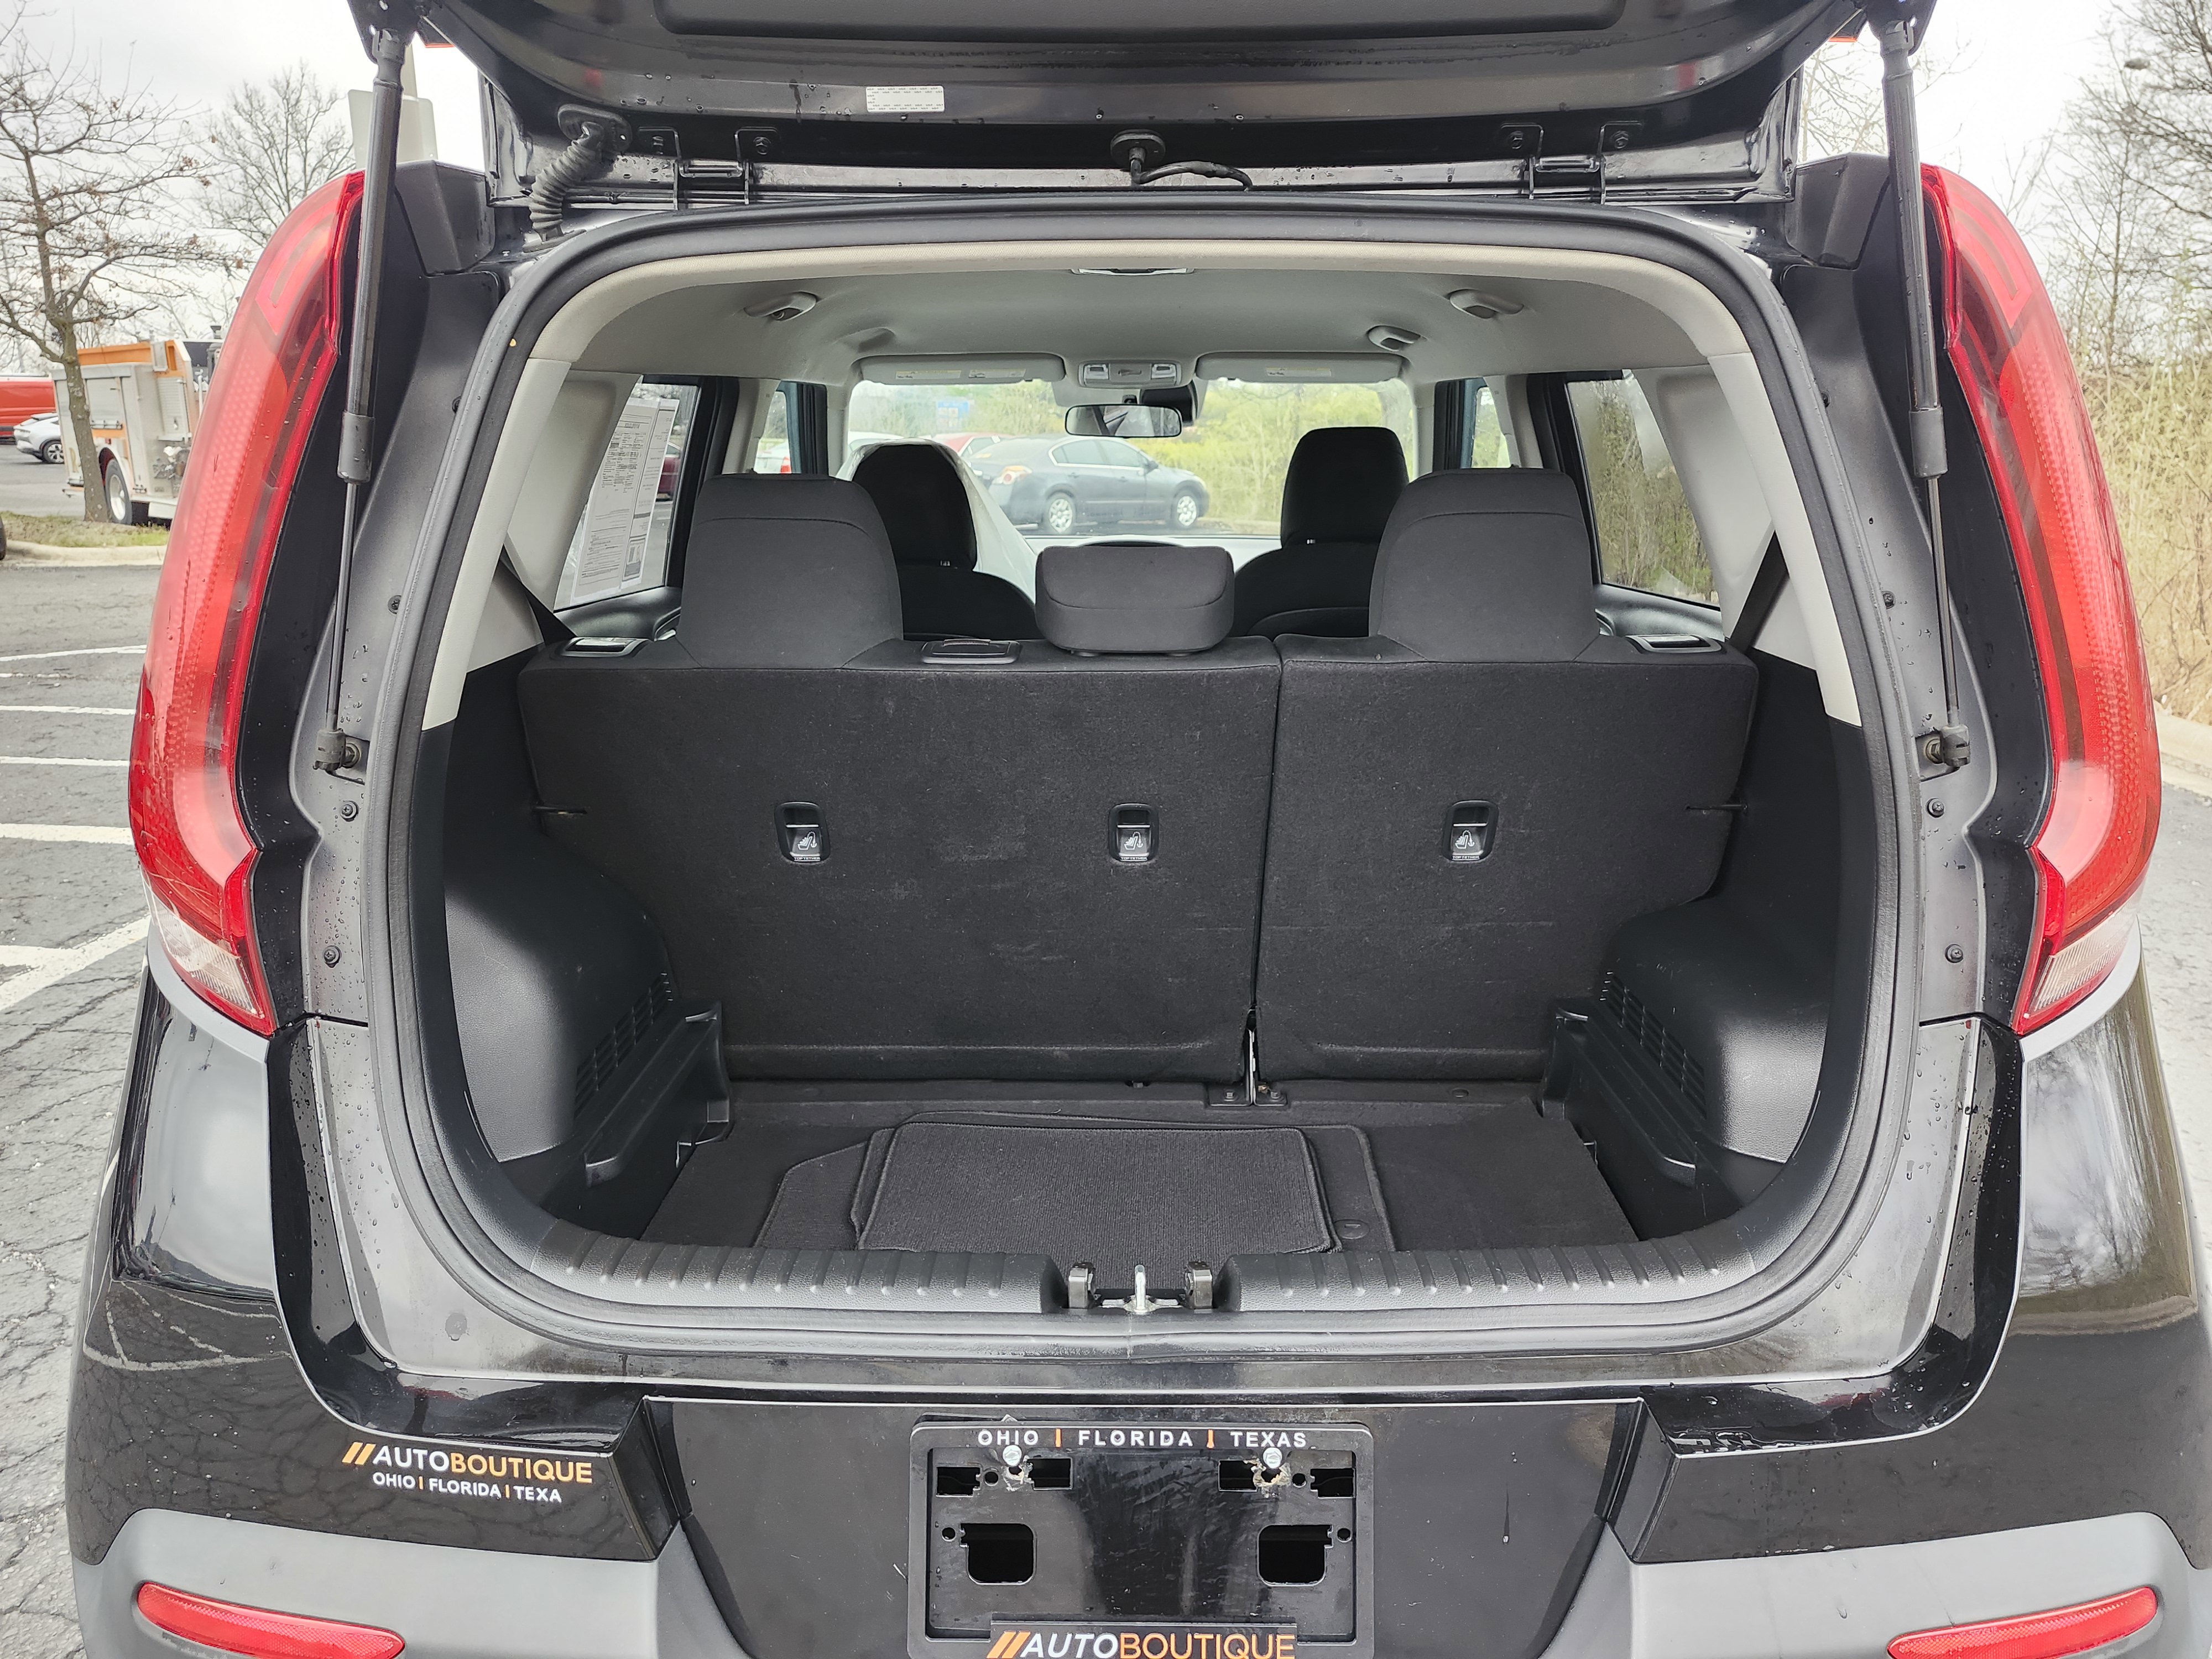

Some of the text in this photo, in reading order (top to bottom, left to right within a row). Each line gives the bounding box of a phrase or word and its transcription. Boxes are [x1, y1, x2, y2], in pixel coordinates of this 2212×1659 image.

[978, 1429, 1306, 1447] OHIO FLORIDA TEXAS
[372, 1472, 562, 1504] OHIO FLORIDA TEXA
